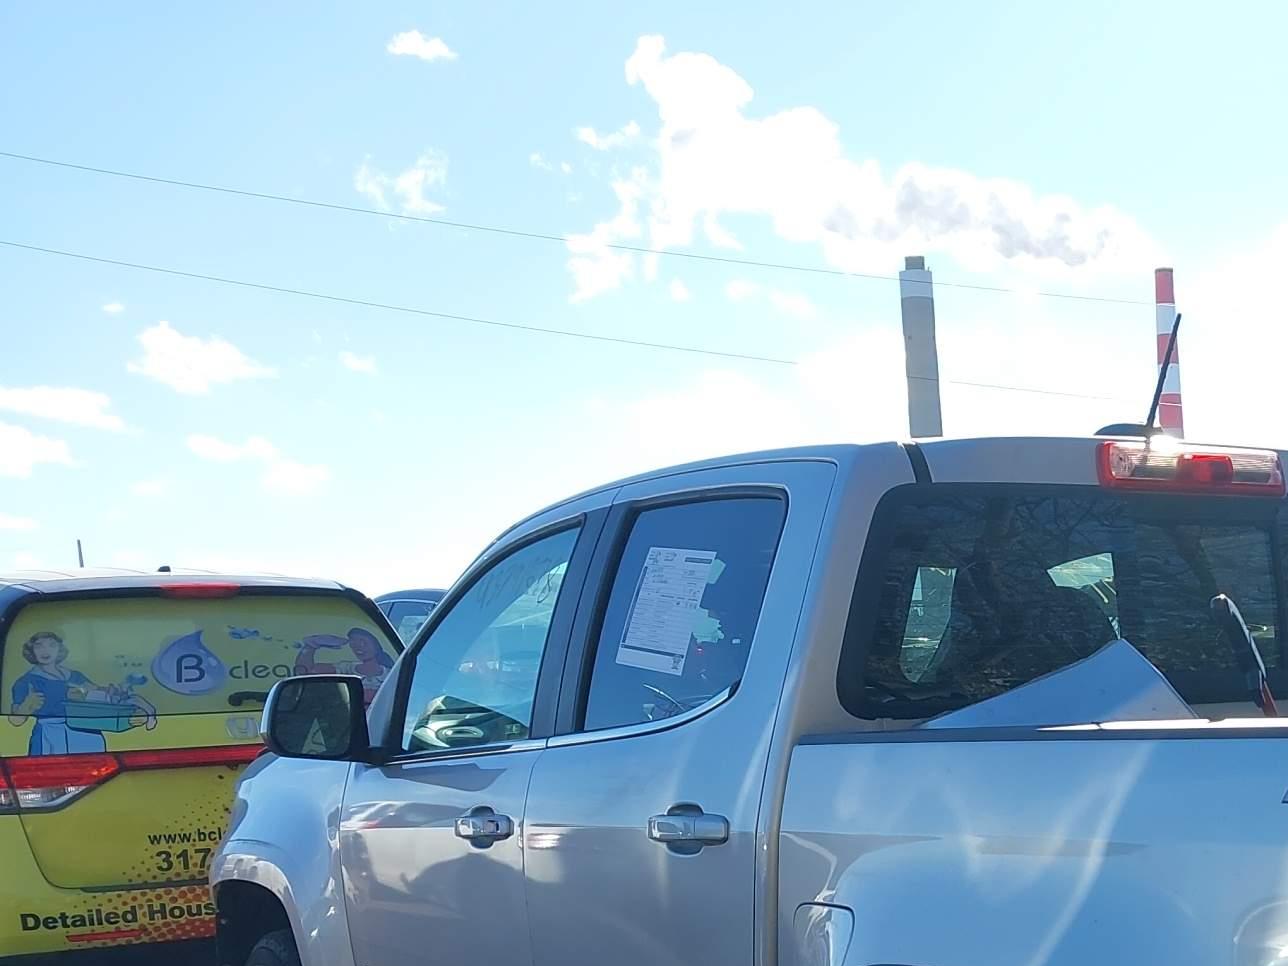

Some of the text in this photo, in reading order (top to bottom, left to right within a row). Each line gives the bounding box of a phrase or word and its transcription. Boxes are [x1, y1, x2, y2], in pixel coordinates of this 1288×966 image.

[176, 654, 206, 684] B
[148, 826, 226, 845] www.bcl
[156, 847, 212, 872] 317
[20, 906, 138, 931] Detailed
